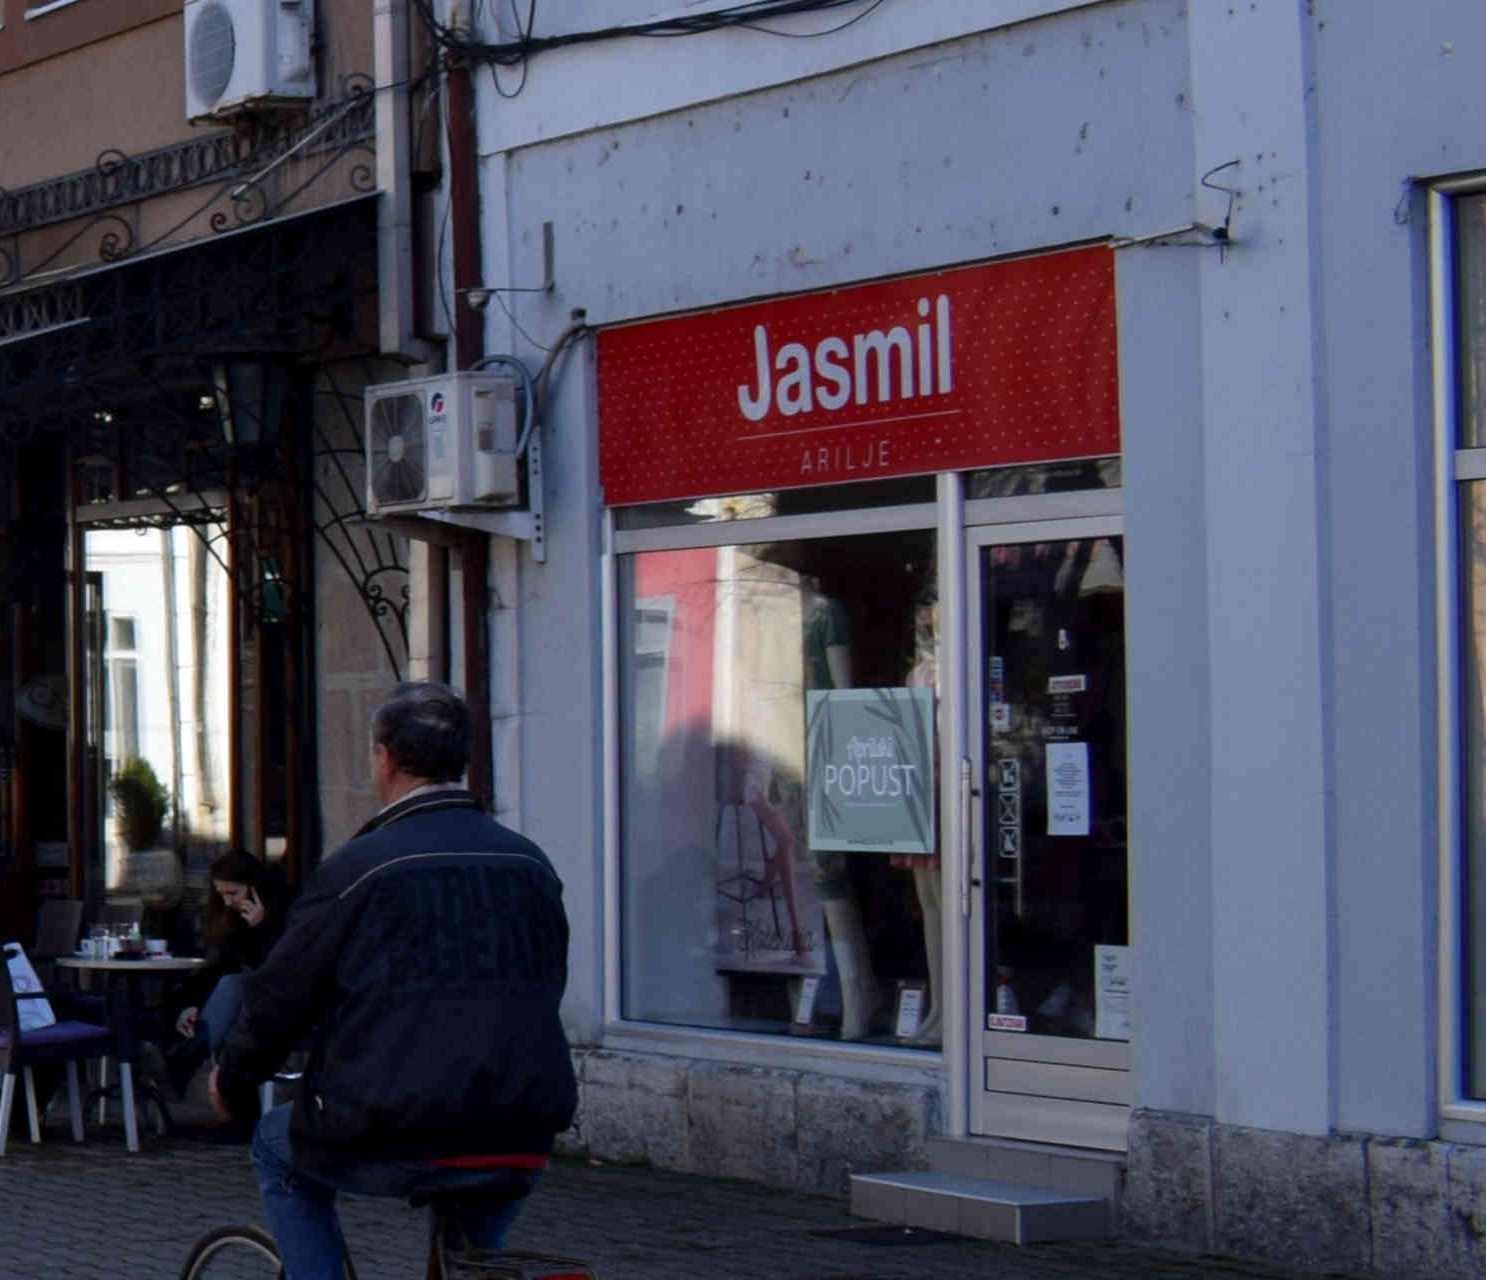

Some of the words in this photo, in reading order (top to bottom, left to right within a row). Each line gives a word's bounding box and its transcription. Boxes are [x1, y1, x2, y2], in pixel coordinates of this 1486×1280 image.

[737, 293, 953, 422] Jasmil
[801, 440, 892, 474] ARILJE
[823, 764, 917, 798] POPUST
